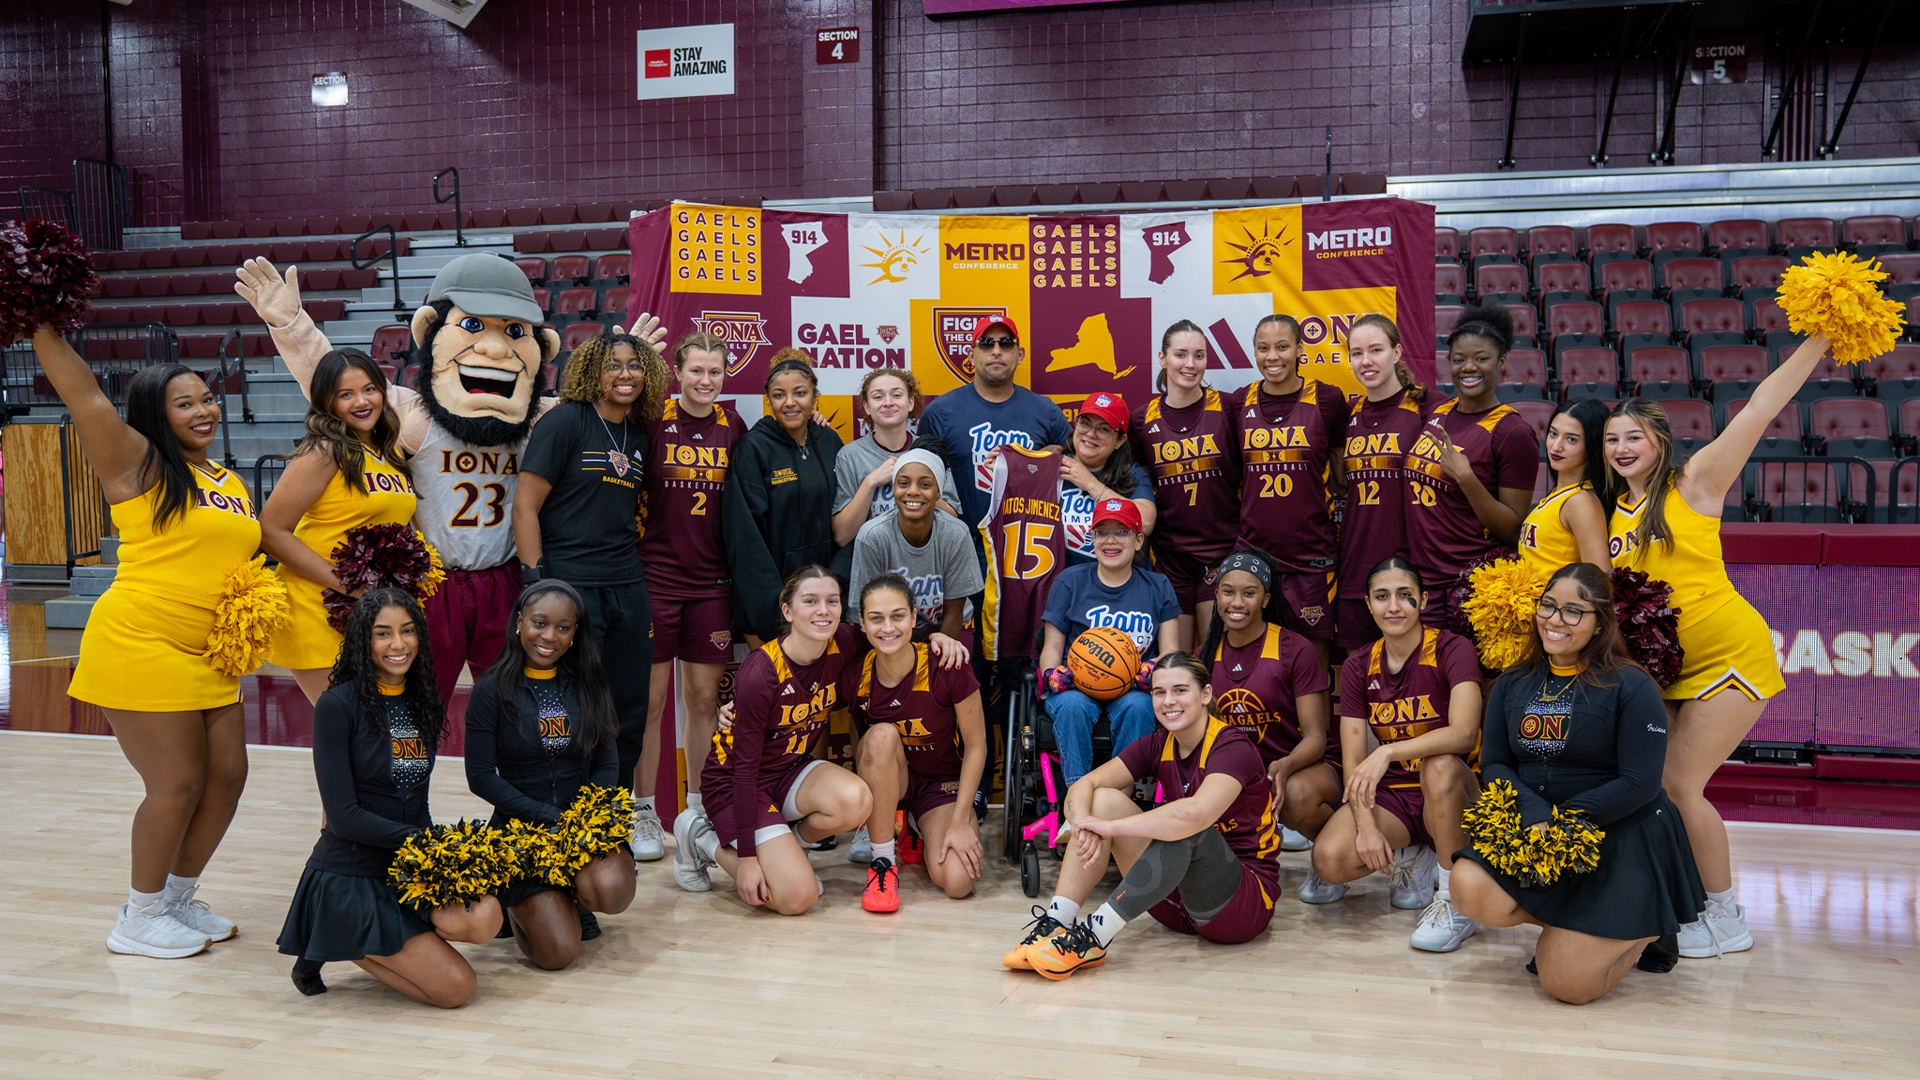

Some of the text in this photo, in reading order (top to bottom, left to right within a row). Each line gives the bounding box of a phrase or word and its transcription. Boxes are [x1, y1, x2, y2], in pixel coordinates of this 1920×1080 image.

[818, 30, 858, 41] SECTION
[674, 47, 702, 61] STAY
[831, 43, 844, 59] 4
[1695, 45, 1746, 58] SECTION
[674, 60, 727, 76] AMAZING
[1713, 59, 1726, 79] 5
[314, 75, 346, 85] SECTION
[678, 211, 756, 229] GAELS
[678, 229, 757, 247] GAELS
[792, 230, 817, 244] 914
[1033, 224, 1117, 237] GAELS
[1152, 231, 1181, 246] 914
[1307, 226, 1392, 251] METRO
[678, 247, 757, 265] GAELS
[944, 243, 1025, 261] METRO
[1033, 240, 1117, 254] GAELS
[1316, 248, 1384, 259] CONFERENCE
[1033, 257, 1117, 271] GAELS
[678, 266, 757, 282] GAELS
[1033, 273, 1117, 287] GAELS
[697, 320, 766, 342] IONA
[943, 317, 977, 330] FIG
[798, 323, 869, 345] GAEL
[944, 333, 966, 341] THE
[799, 348, 905, 368] NATION
[949, 344, 972, 355] FIG
[1298, 352, 1352, 365] GAE
[1063, 408, 1079, 423] 91
[969, 422, 1034, 453] Team
[1244, 426, 1311, 450] IONA
[1343, 433, 1402, 458] IONA
[663, 443, 730, 468] IONA
[1152, 434, 1221, 464] IONA
[439, 450, 519, 475] IONA
[363, 472, 415, 495] IONA
[602, 475, 635, 489] BASKETBALL
[1259, 474, 1293, 497] 20
[1184, 483, 1198, 506] 7
[1357, 481, 1380, 506] 12
[197, 487, 260, 522] IONA
[450, 481, 506, 528] 23
[690, 491, 708, 516] 2
[1003, 497, 1060, 522] ATOS JIMENEZ
[1064, 515, 1092, 524] IMP
[1002, 520, 1056, 580] 15
[1078, 635, 1116, 669] Wilson
[777, 682, 837, 726] IONA
[1369, 695, 1440, 724] IONA
[1520, 714, 1570, 739] ON
[391, 737, 429, 759] ONA
